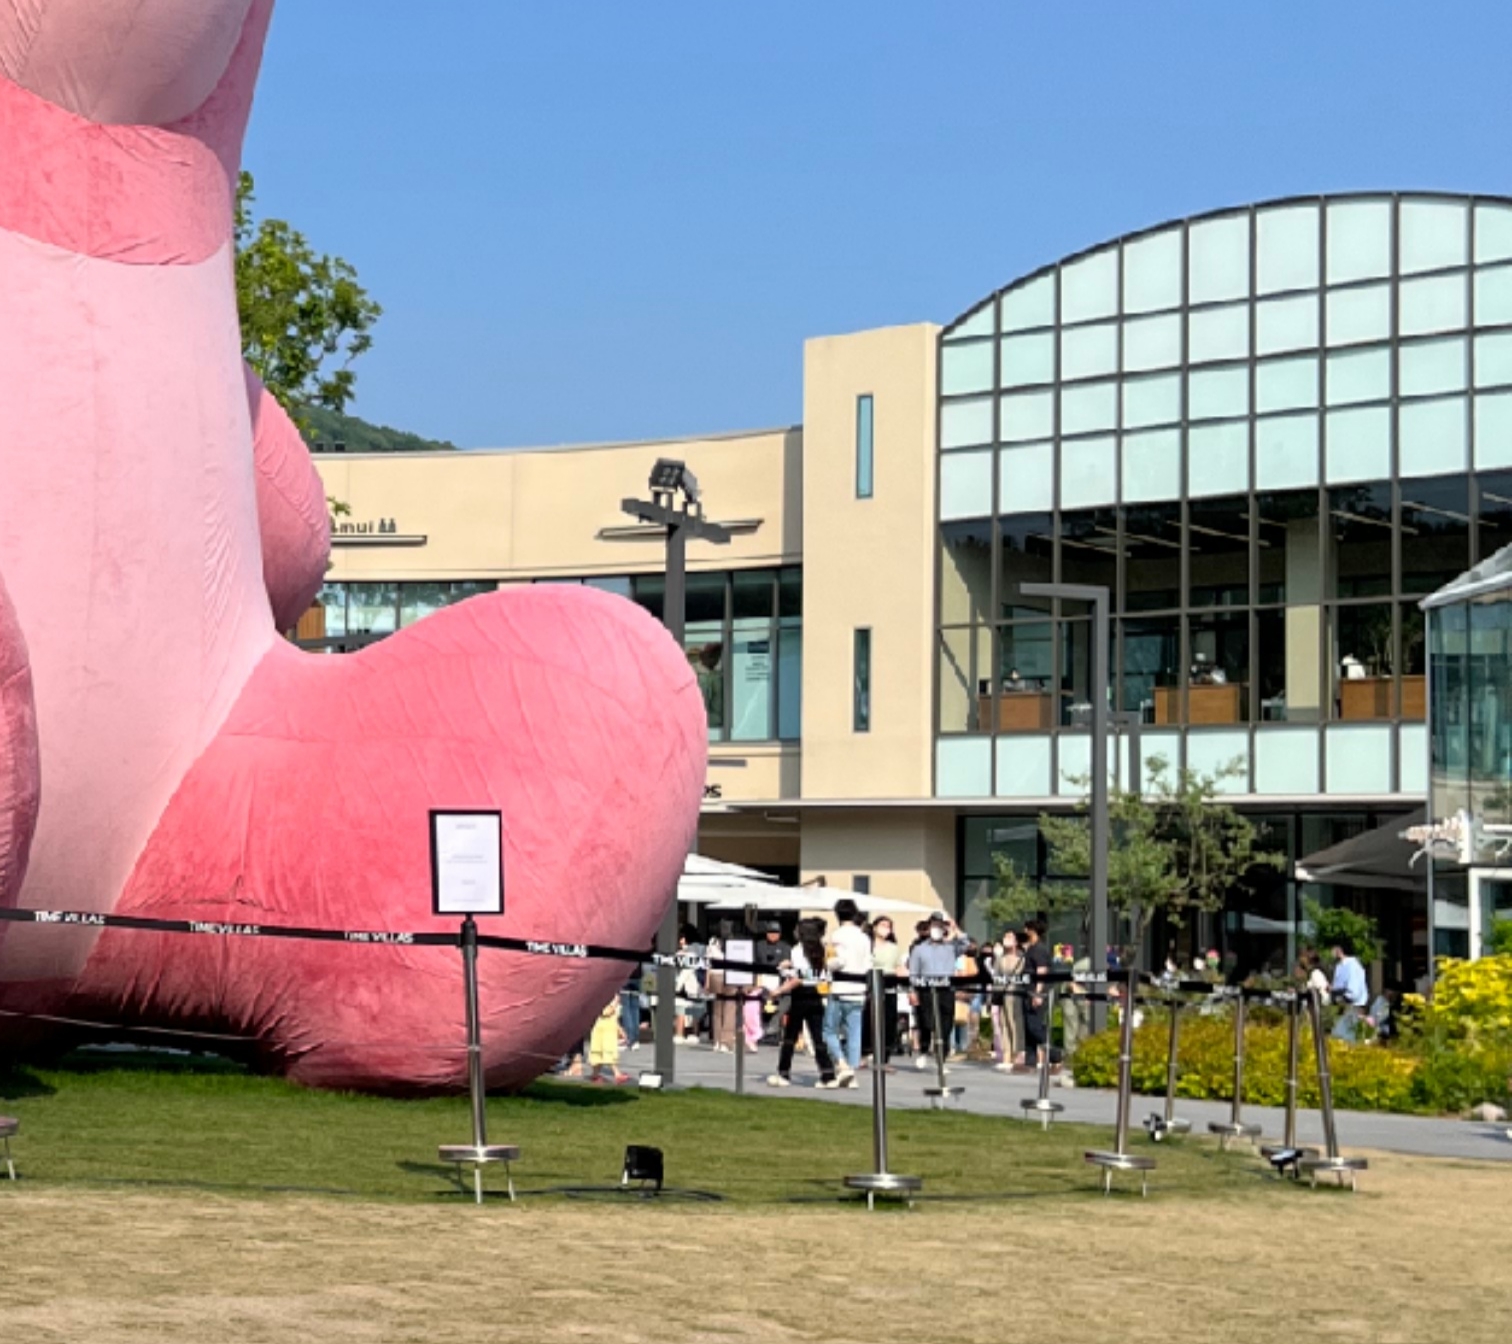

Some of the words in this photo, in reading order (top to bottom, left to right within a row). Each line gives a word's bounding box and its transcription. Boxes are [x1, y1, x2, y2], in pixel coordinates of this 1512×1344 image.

[34, 911, 62, 923] TIME
[65, 913, 105, 925] VILLAS
[189, 921, 217, 933] TIME
[218, 923, 260, 935] VILLAS
[344, 931, 370, 942] TIME
[371, 932, 413, 945] VILLAS
[526, 941, 551, 954] TIME
[553, 944, 588, 958] VILLAS
